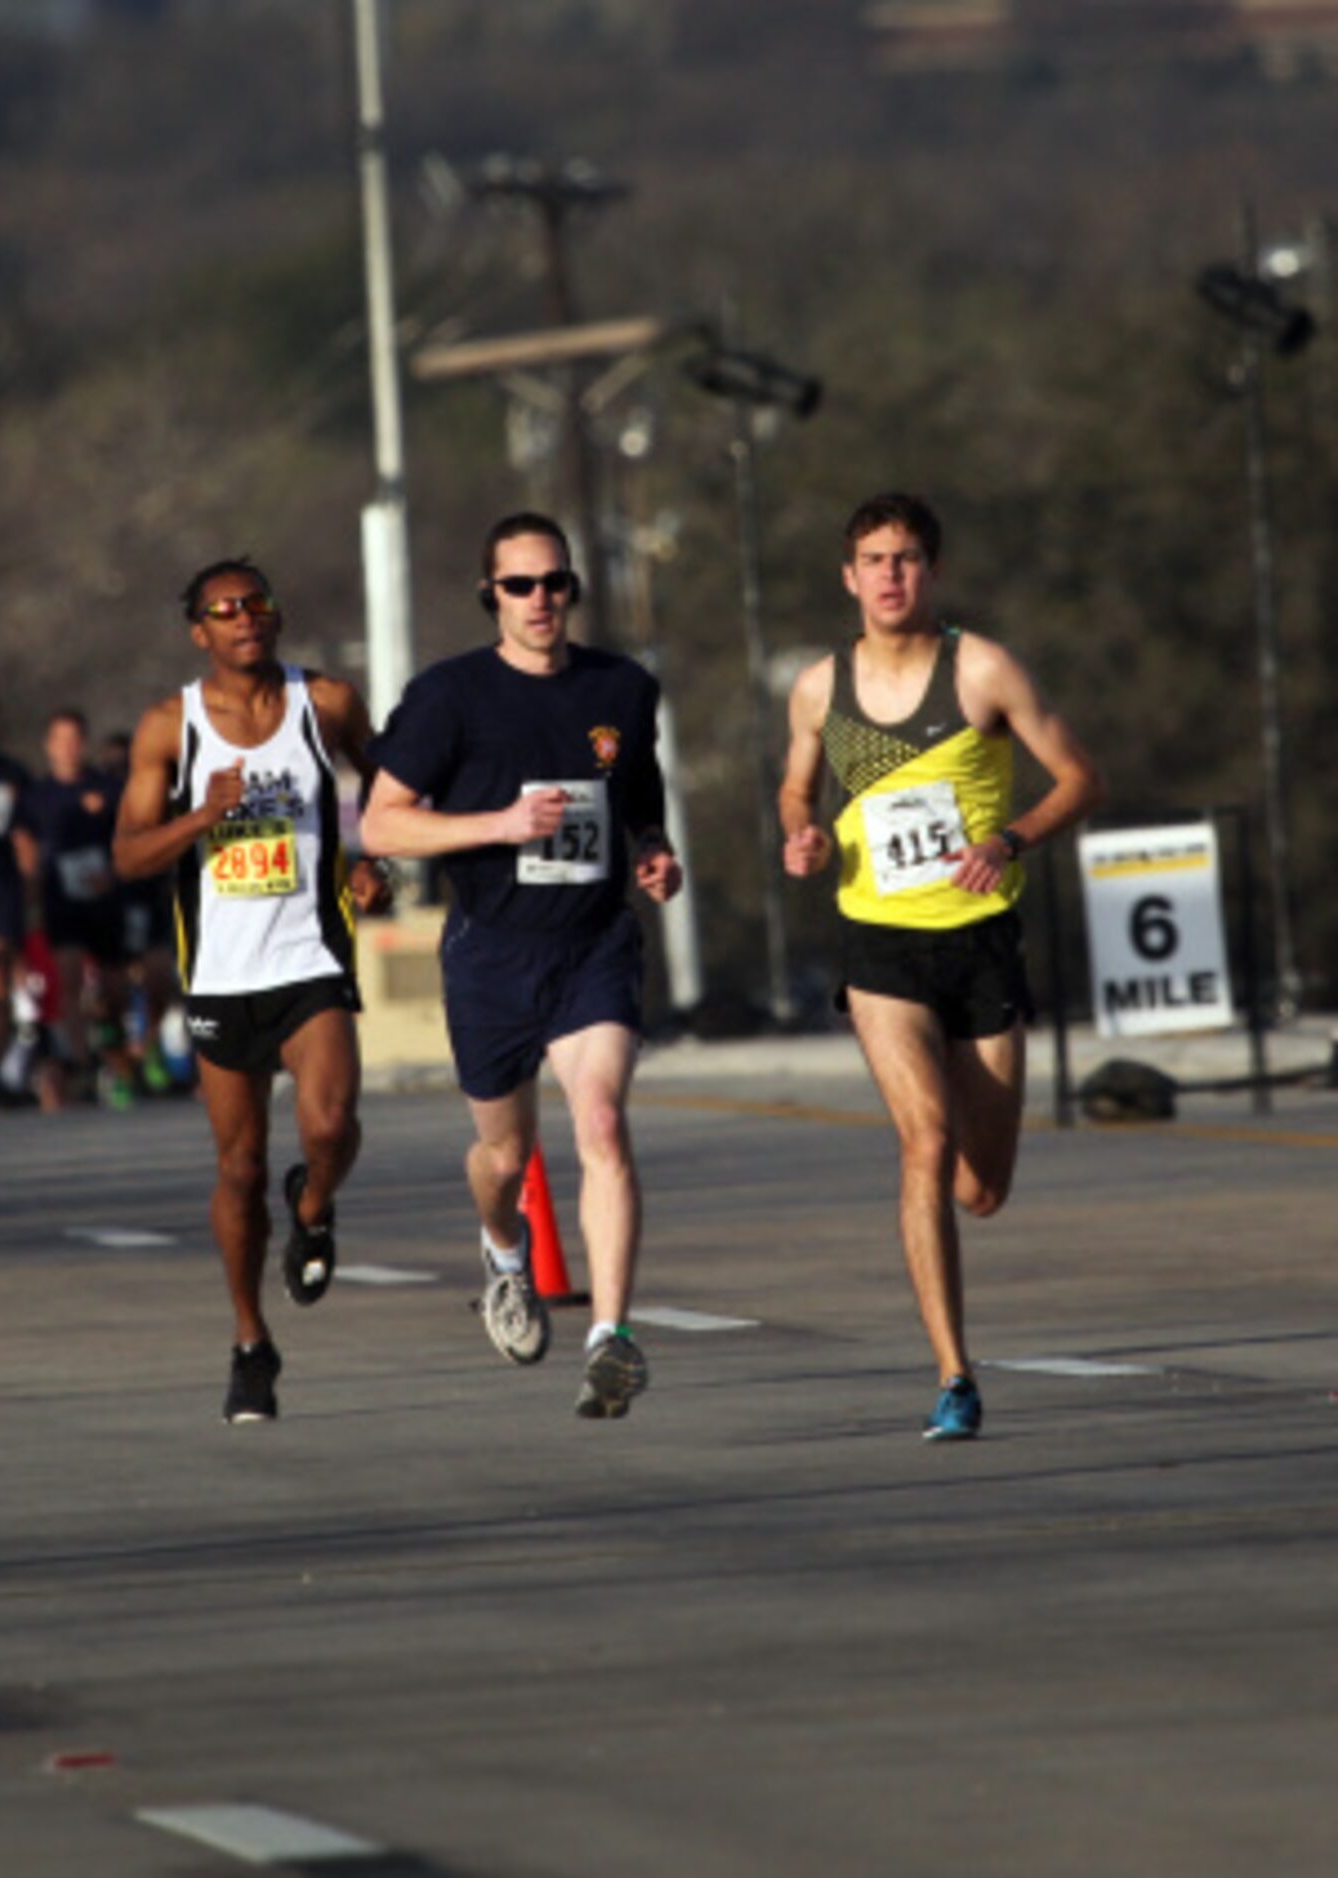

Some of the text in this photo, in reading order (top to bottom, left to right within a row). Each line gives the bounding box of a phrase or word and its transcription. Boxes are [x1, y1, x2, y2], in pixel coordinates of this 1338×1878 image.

[212, 839, 290, 881] 2894
[1129, 895, 1180, 964] 6
[1104, 970, 1219, 1013] MILE
